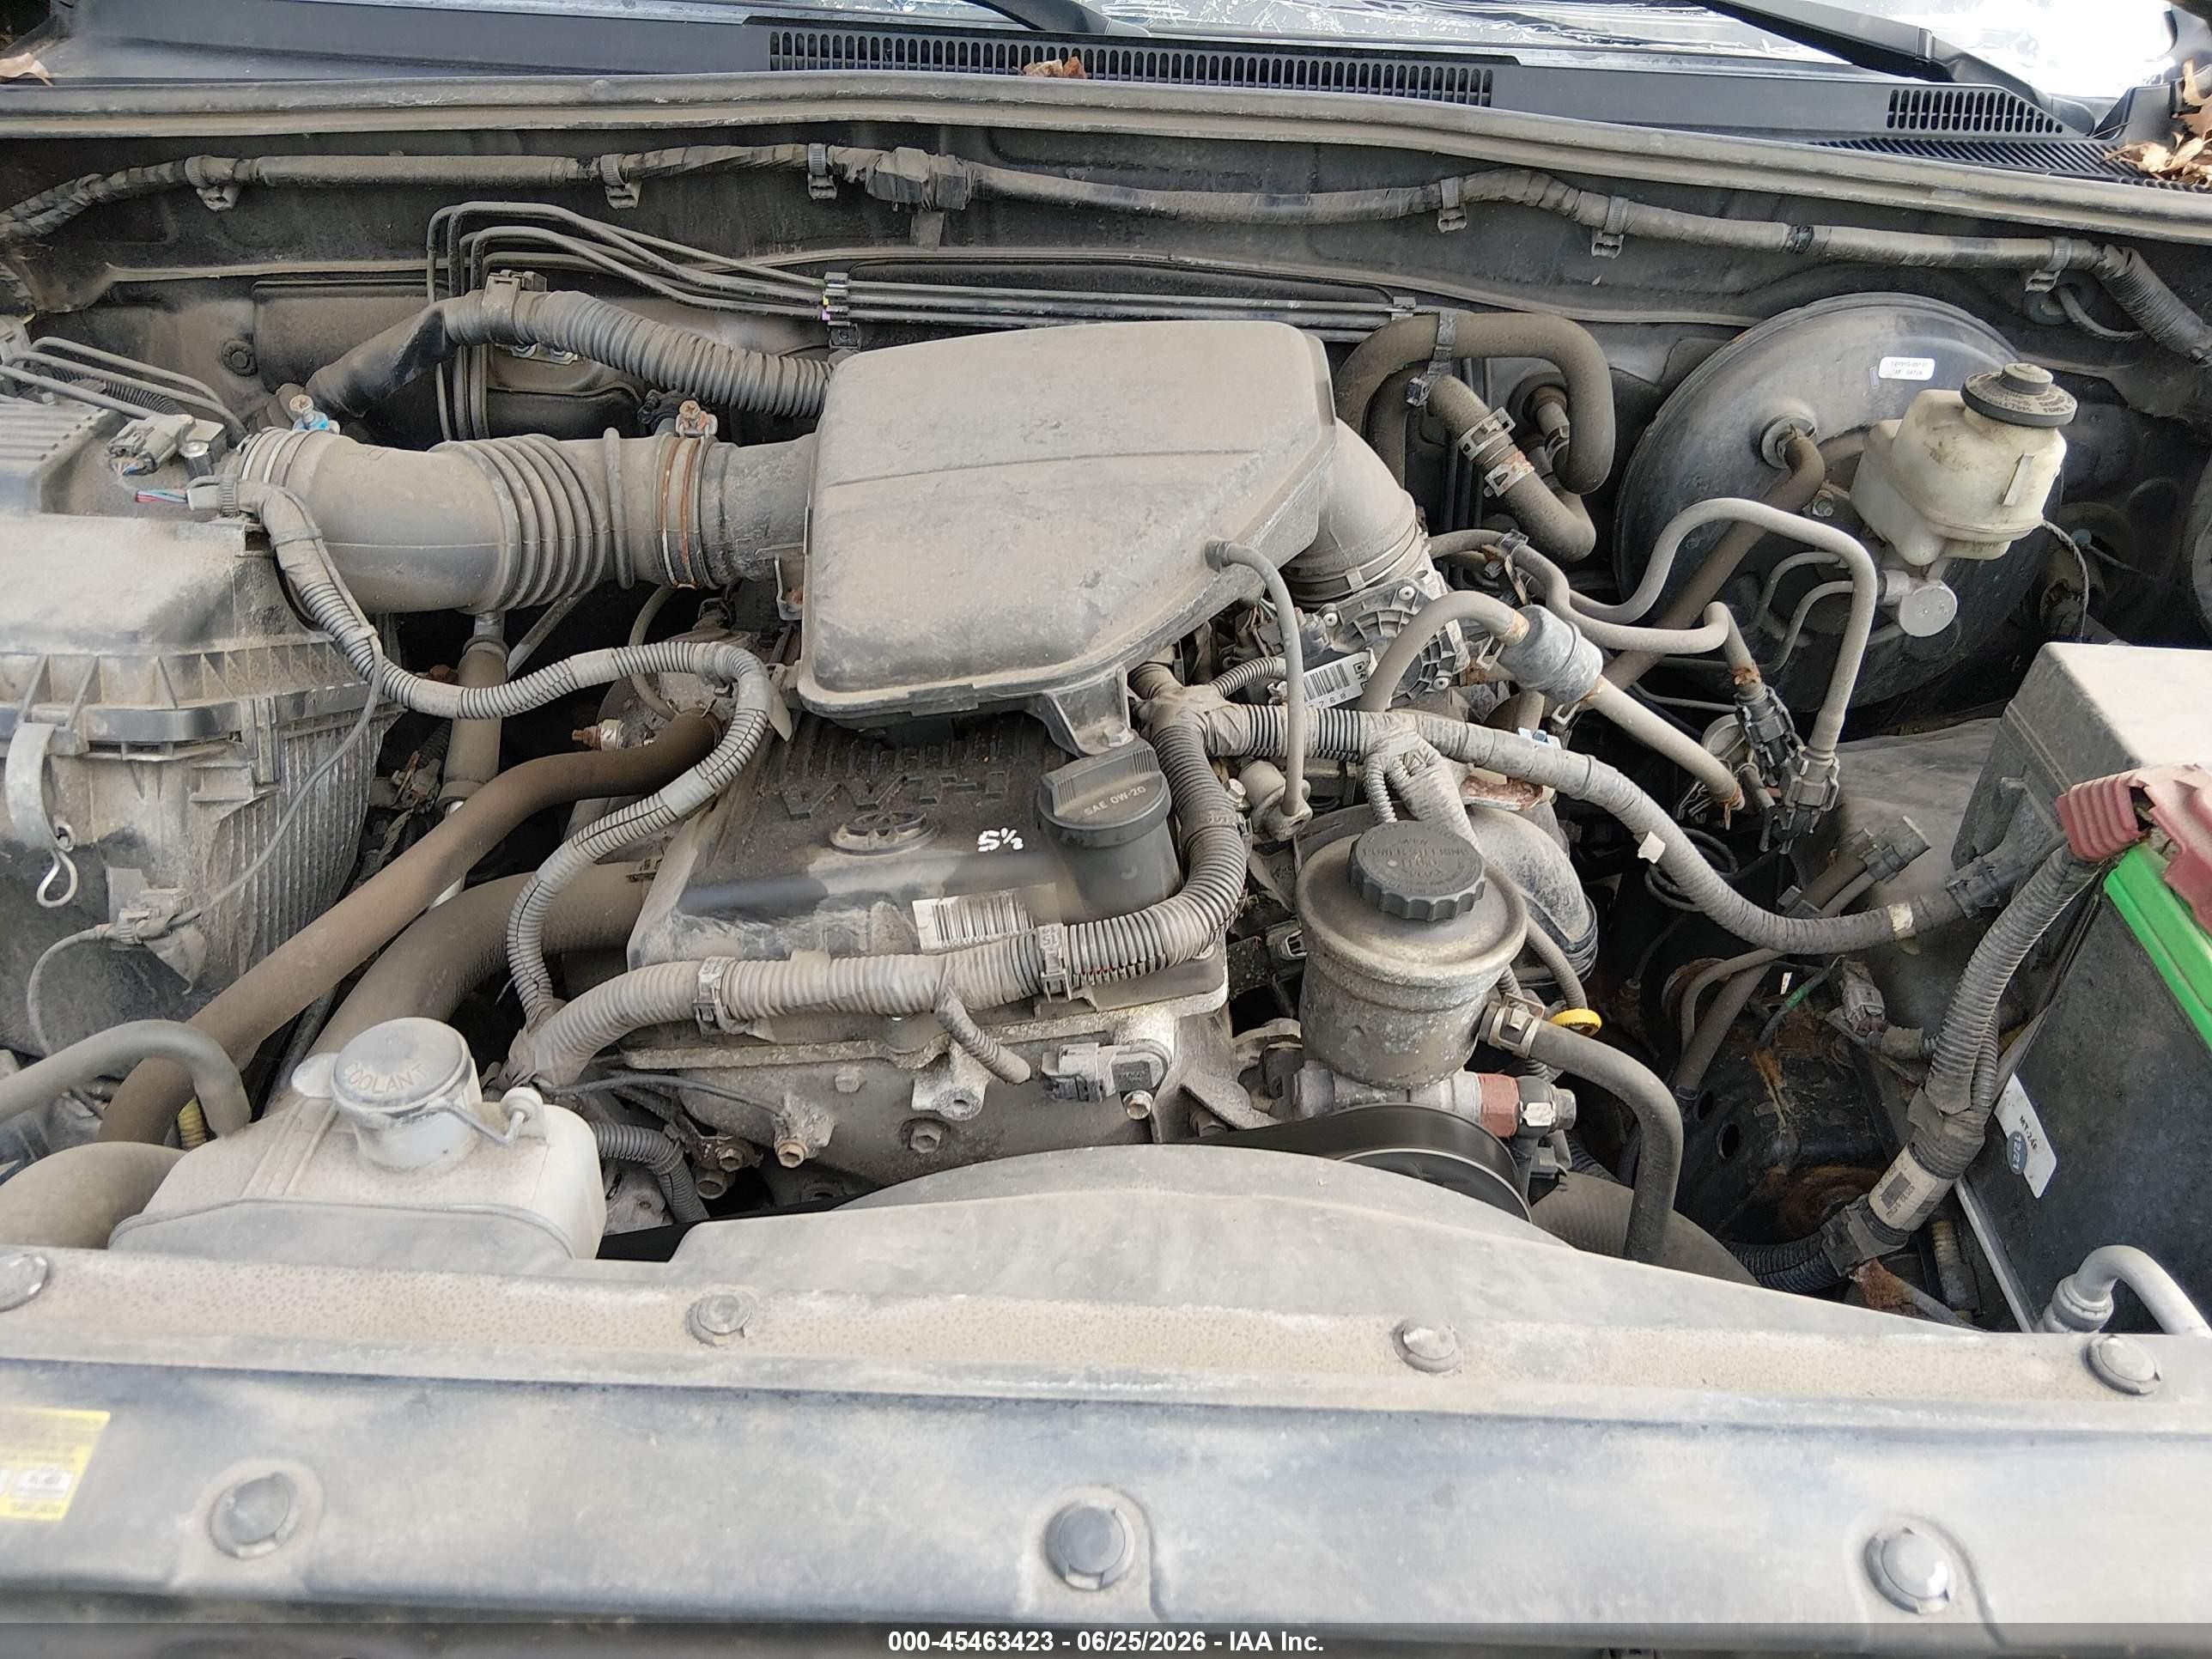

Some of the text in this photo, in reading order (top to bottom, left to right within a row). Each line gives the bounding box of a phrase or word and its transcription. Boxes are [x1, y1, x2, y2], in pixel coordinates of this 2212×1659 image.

[1084, 786, 1146, 816] SAE 0W-20
[343, 1060, 428, 1094] COOLANT
[2012, 1134, 2022, 1170] 12/21
